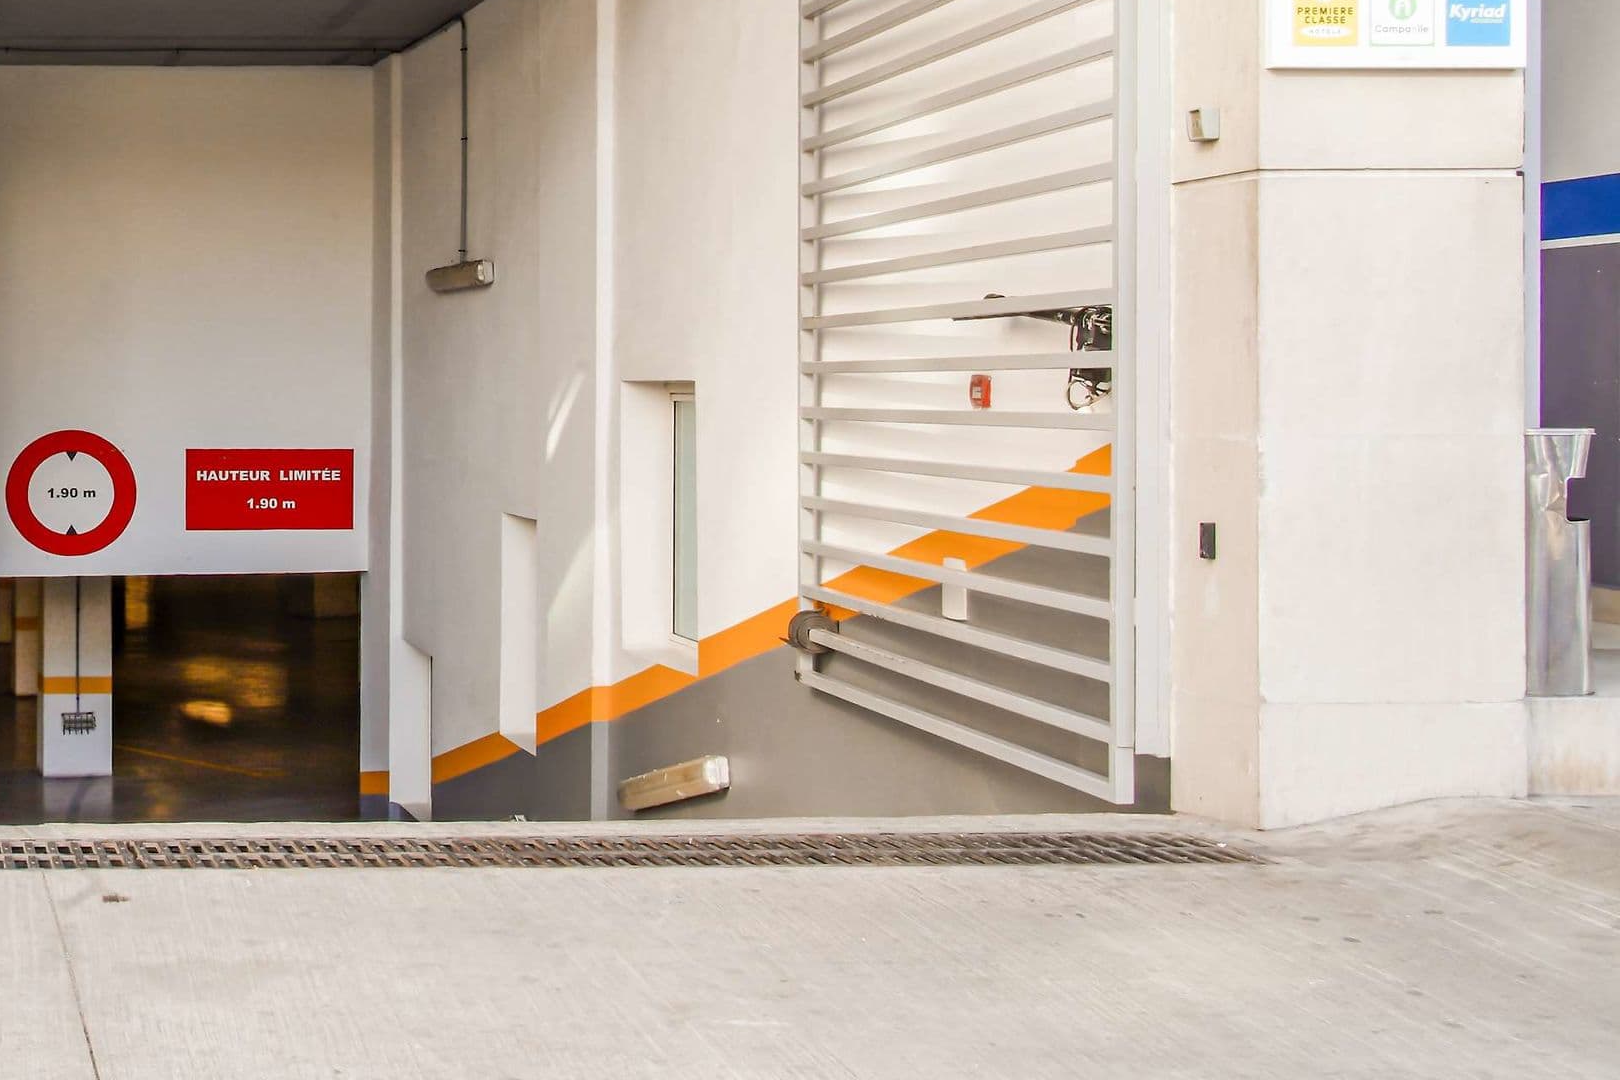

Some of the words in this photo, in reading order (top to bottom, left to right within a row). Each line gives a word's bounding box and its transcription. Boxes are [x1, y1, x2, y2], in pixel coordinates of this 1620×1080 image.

[1296, 6, 1355, 16] PREMIERE
[1448, 3, 1507, 22] Kyriad
[1304, 15, 1347, 25] CLASSE
[1374, 23, 1429, 34] Campanile
[196, 469, 271, 481] HAUTEUR
[279, 467, 342, 481] LIMITÉE
[47, 487, 79, 499] 1.90
[83, 489, 97, 499] m
[246, 498, 278, 509] 1.90
[282, 500, 296, 509] m
